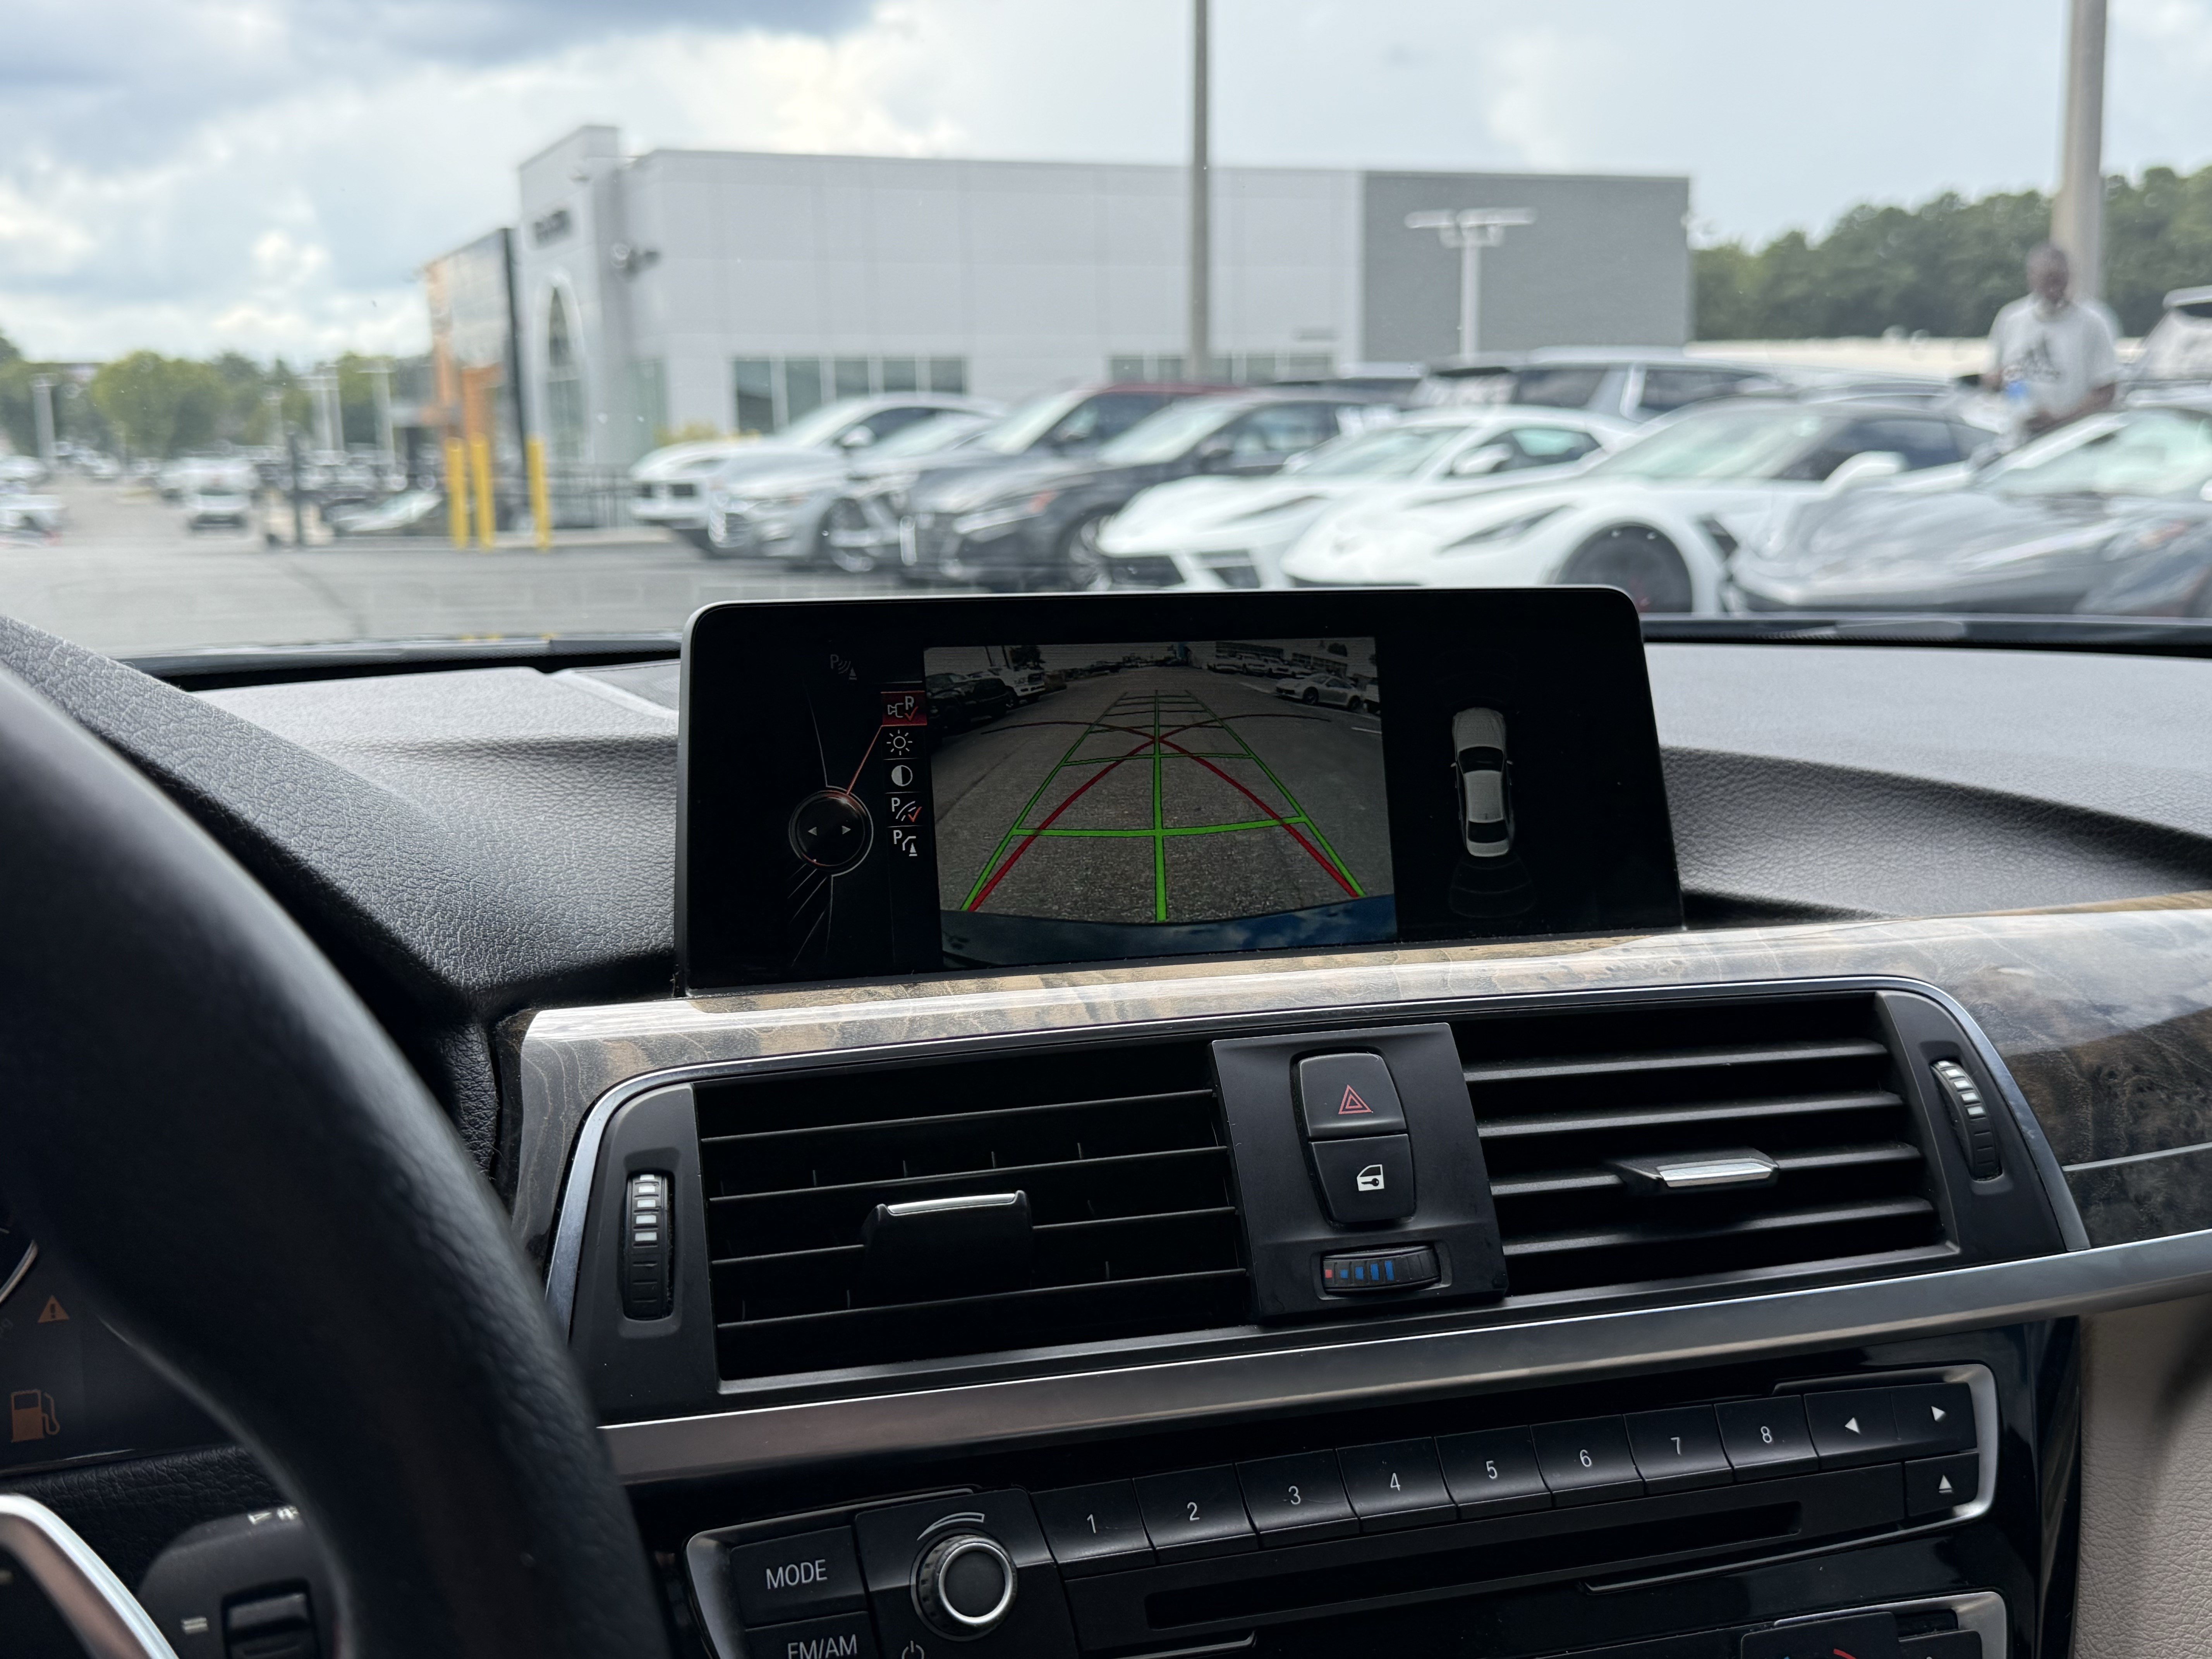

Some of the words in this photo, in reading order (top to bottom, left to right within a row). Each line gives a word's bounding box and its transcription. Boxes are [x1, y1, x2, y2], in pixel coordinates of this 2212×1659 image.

[905, 696, 914, 710] R
[891, 797, 900, 812] P
[893, 830, 902, 845] P
[1087, 1514, 1096, 1534] 1
[1187, 1502, 1200, 1521] 2
[1288, 1486, 1301, 1505] 3
[1389, 1472, 1401, 1492] 4
[1486, 1460, 1498, 1480] 5
[1579, 1449, 1592, 1468] 6
[1670, 1436, 1681, 1455] 7
[1760, 1426, 1772, 1444] 8
[766, 1559, 828, 1589] MODE
[787, 1634, 857, 1659] FM/AM
